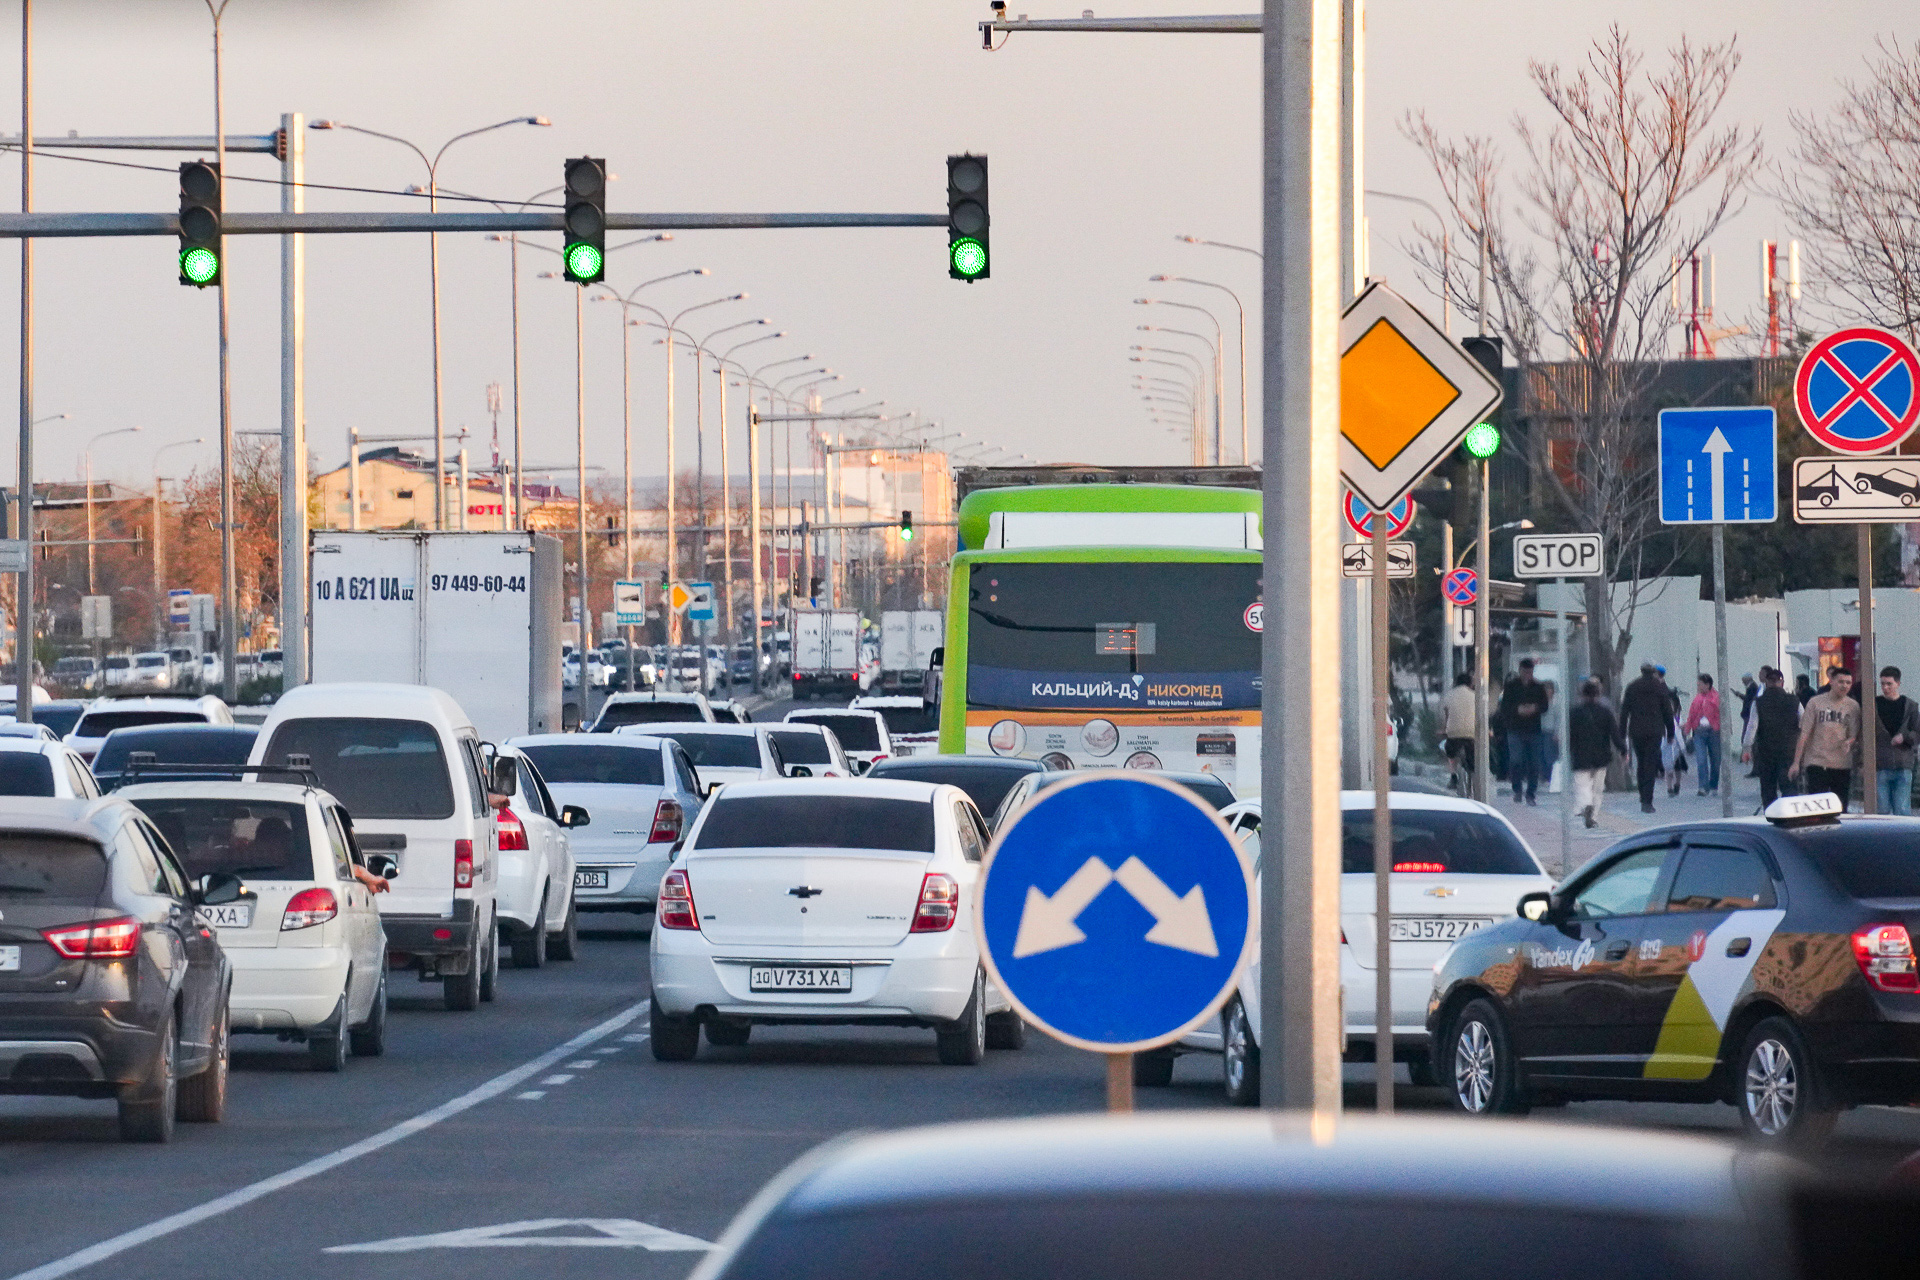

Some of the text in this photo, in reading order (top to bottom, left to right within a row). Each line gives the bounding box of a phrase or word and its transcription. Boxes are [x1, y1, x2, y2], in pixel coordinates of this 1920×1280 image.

[1523, 543, 1595, 568] STOP
[317, 581, 330, 600] 10
[336, 577, 344, 600] A
[350, 577, 375, 600] 621
[432, 575, 526, 592] 97 449-60-44
[1147, 685, 1222, 699] НИКОМЕД
[1791, 799, 1831, 813] TAXI
[1531, 945, 1573, 969] Yandex
[755, 971, 770, 984] 10
